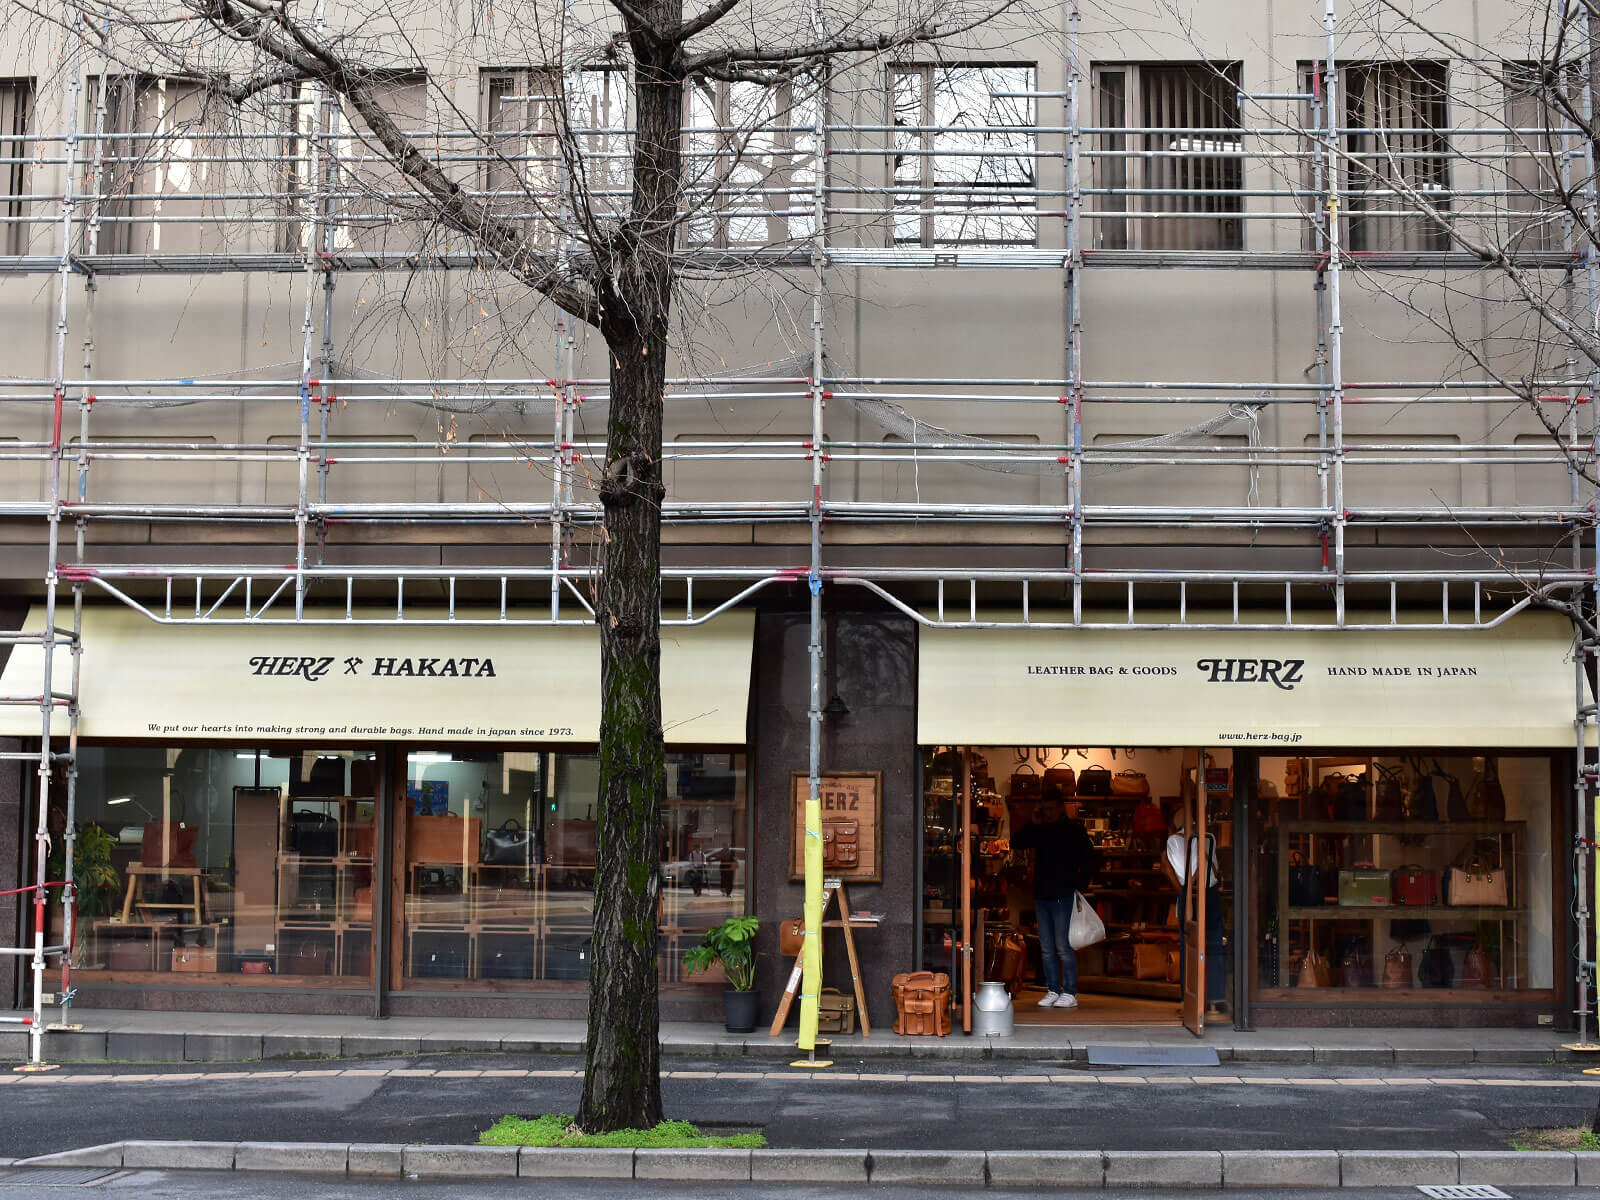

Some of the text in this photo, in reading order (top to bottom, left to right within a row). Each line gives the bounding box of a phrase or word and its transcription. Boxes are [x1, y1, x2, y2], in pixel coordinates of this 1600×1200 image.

[249, 656, 497, 682] HERZ HAKATA
[1027, 665, 1178, 676] LEATHER BAG & GOODS
[1196, 658, 1305, 691] HERZ
[1327, 666, 1478, 678] HAND MADE IN JAPAN
[147, 723, 575, 738] We put our hearts into making strong and durable bags. Hand made in japan since 1973.
[1217, 731, 1303, 744] www.herz-bag.jp
